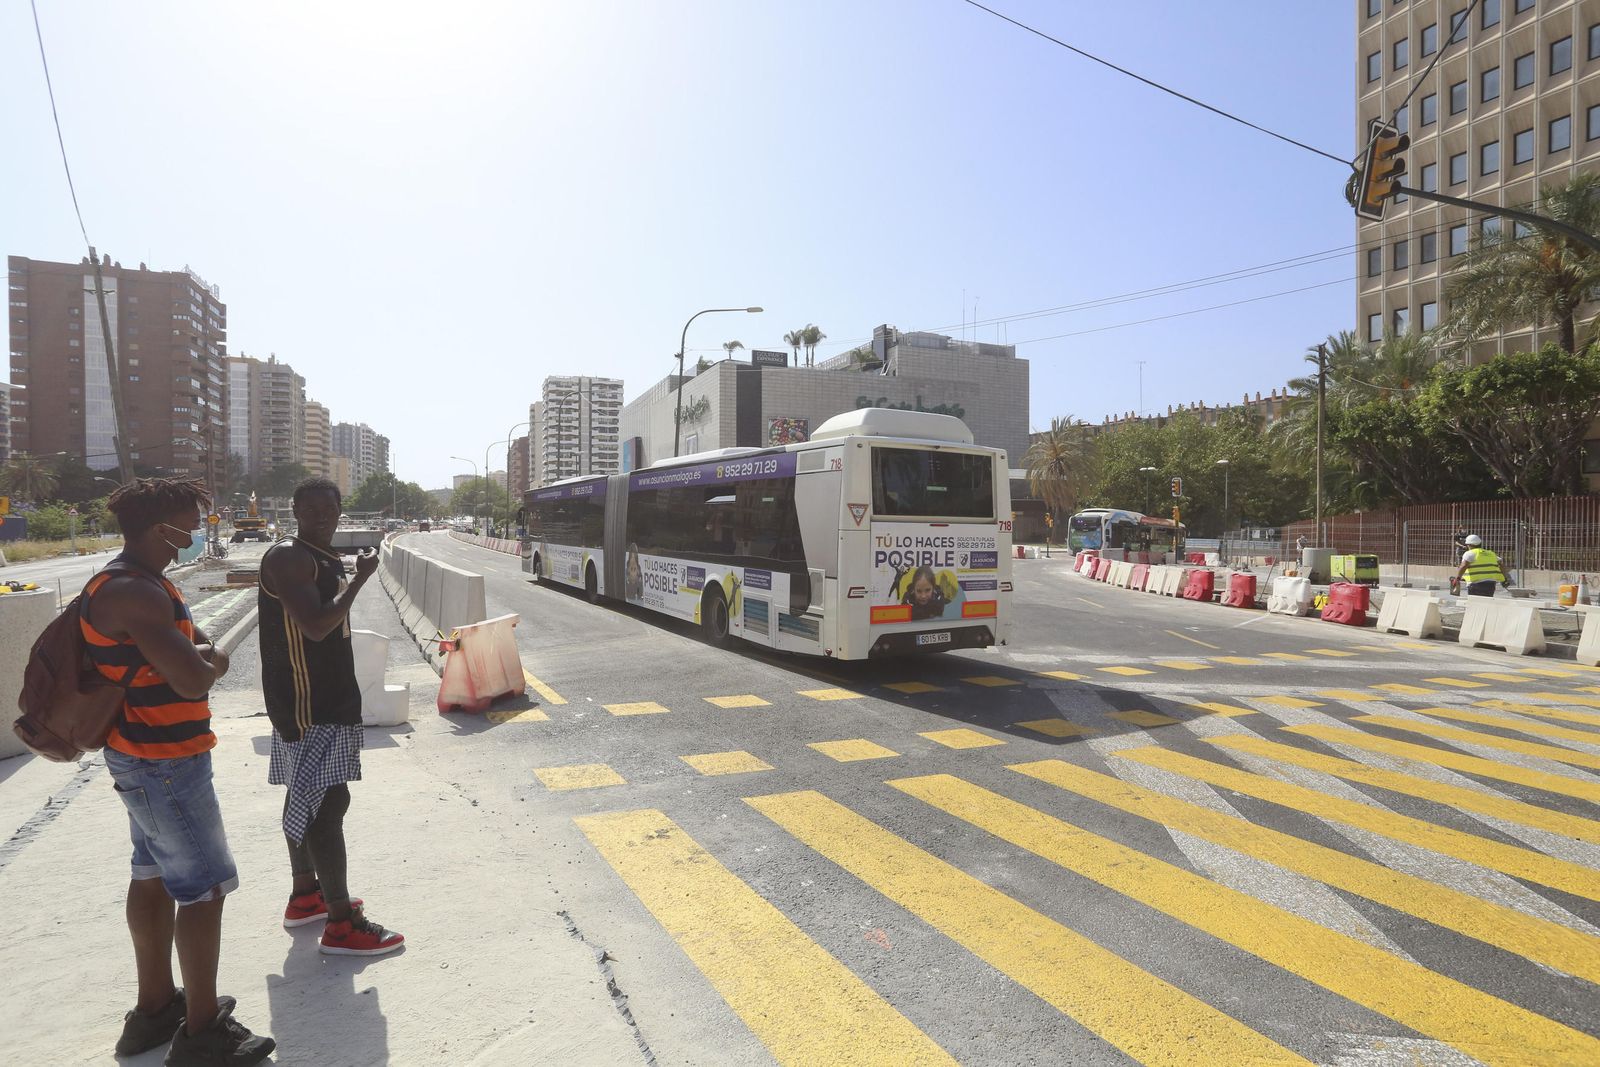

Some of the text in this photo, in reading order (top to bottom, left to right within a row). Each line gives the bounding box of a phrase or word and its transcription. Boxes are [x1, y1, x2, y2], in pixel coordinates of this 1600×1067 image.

[725, 460, 777, 477] 952 29 71 29
[831, 458, 842, 470] 718
[638, 471, 701, 485] www.asuncionmalaga.es
[999, 521, 1012, 531] 718
[875, 533, 955, 548] TÚ LO HACES
[875, 550, 955, 568] POSIBLE
[651, 561, 658, 571] LO
[659, 562, 678, 575] HACES
[644, 573, 678, 595] POSIBLE
